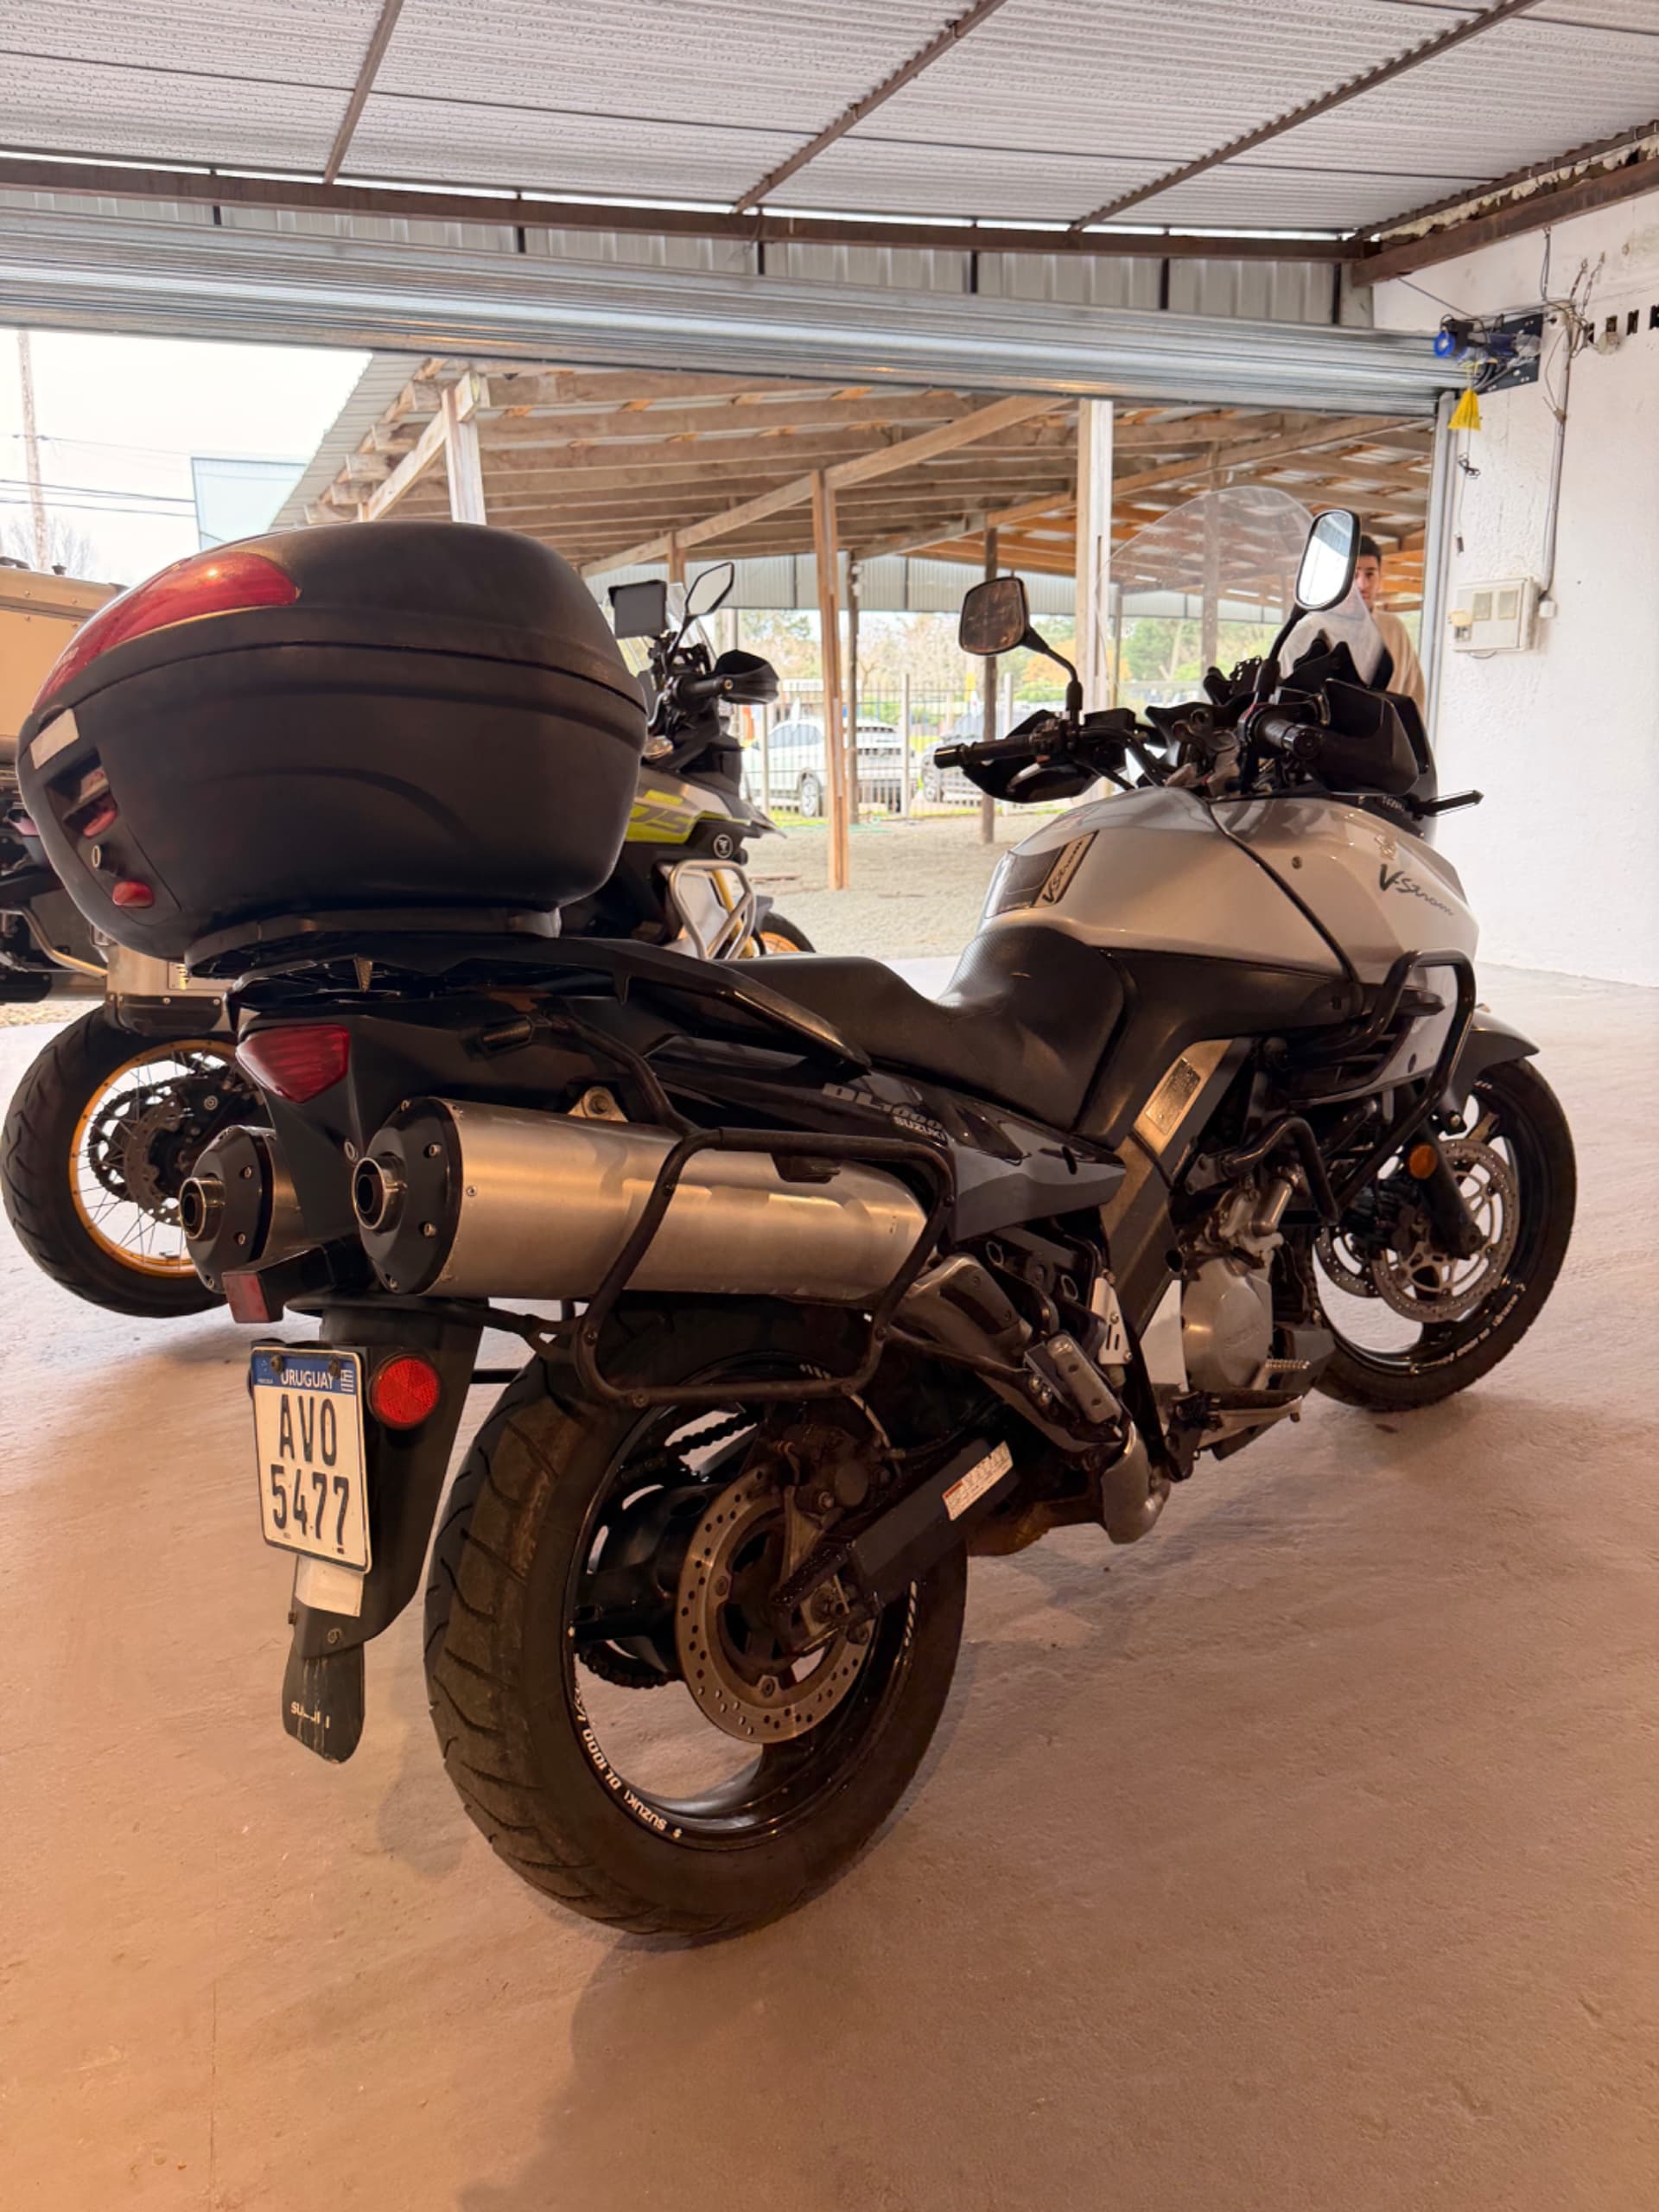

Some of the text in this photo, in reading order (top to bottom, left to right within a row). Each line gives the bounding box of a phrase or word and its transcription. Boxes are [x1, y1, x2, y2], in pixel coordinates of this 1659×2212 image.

[281, 1369, 334, 1389] URUGUAY
[270, 1464, 349, 1546] 5477
[623, 1789, 668, 1832] SUZUKI
